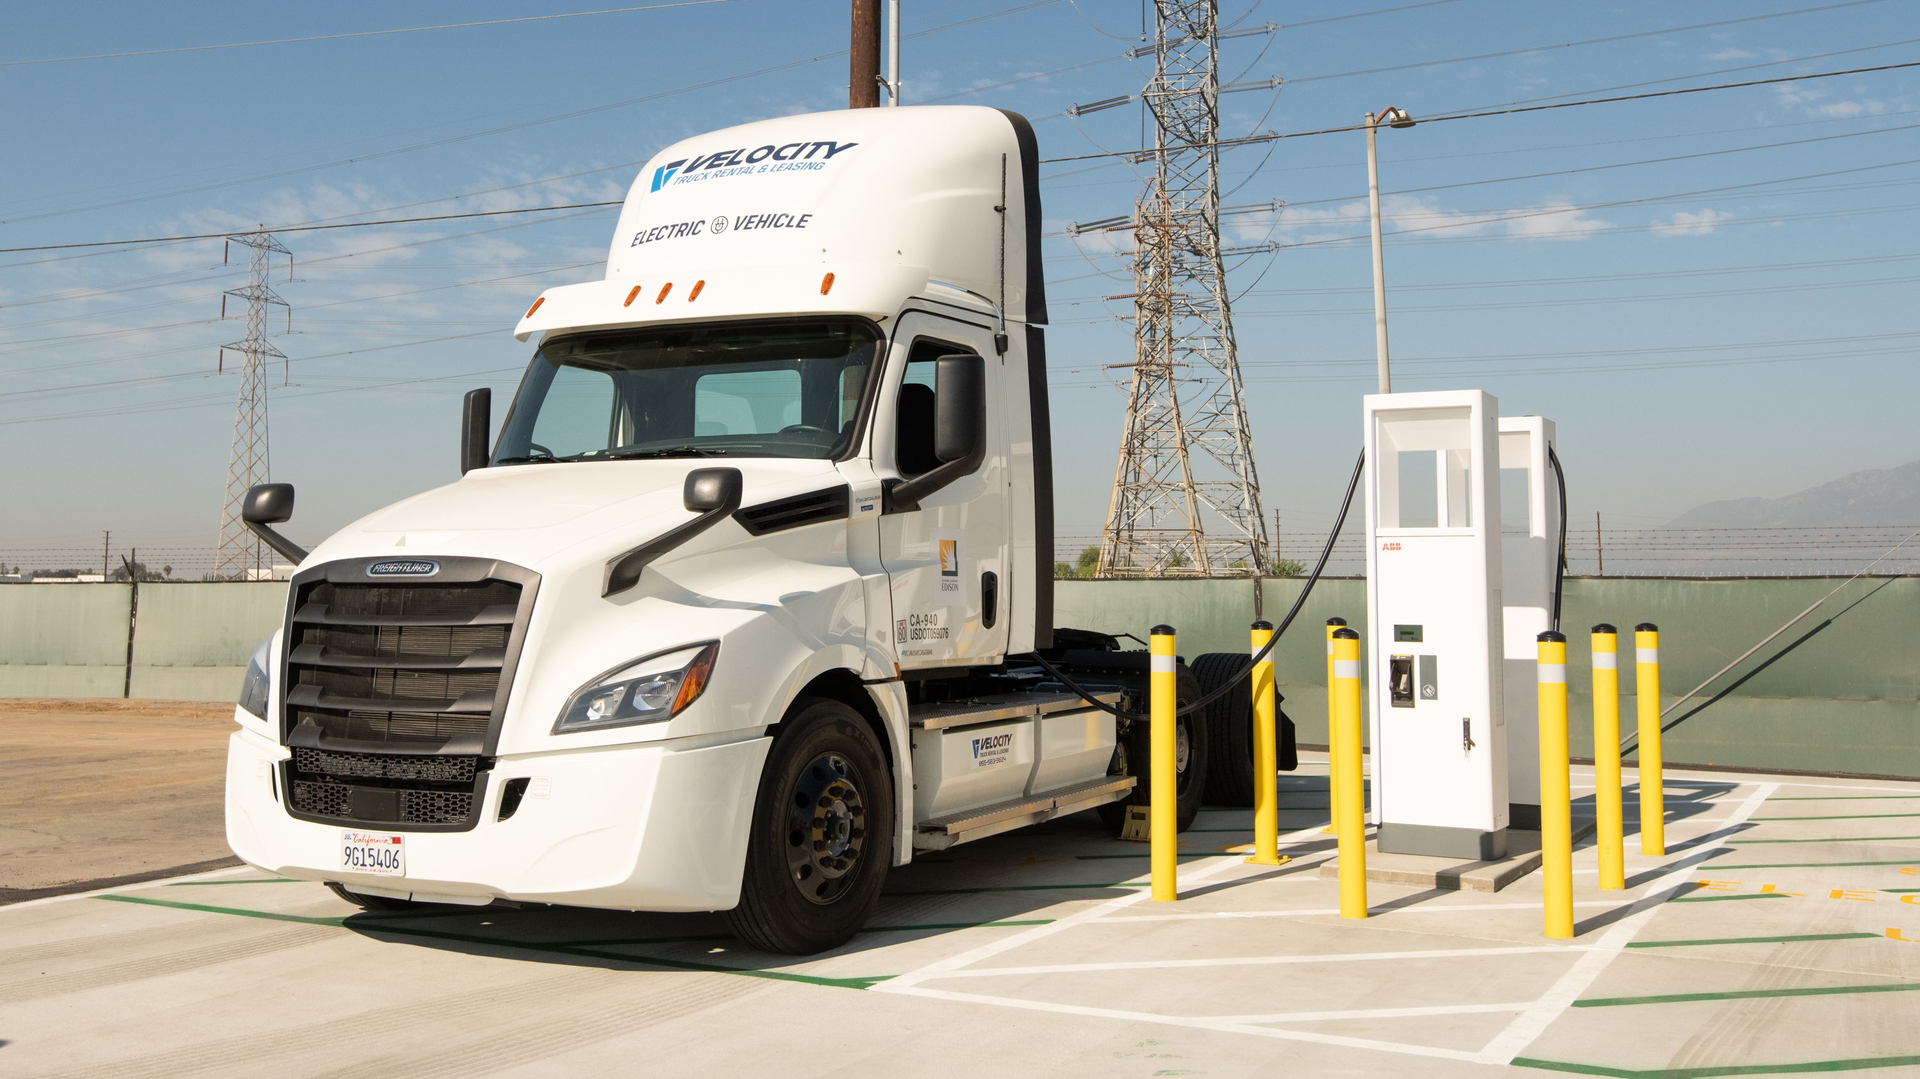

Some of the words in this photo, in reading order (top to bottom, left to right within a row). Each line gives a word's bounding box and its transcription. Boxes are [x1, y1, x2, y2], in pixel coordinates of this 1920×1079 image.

[682, 141, 859, 174] VELOCITY
[673, 171, 712, 186] TRUCK
[711, 165, 756, 179] RENTAL
[757, 164, 769, 174] &
[769, 162, 826, 173] LEASING
[631, 219, 706, 248] ELECTRIC
[733, 212, 813, 231] VEHICLE
[1382, 542, 1402, 551] ABB
[372, 562, 432, 573] FREIGHTLINER
[941, 582, 959, 592] EDISON
[910, 613, 938, 627] CA-940
[980, 734, 1012, 750] VELOCITY
[353, 833, 388, 846] California
[344, 845, 400, 870] 9G15406
